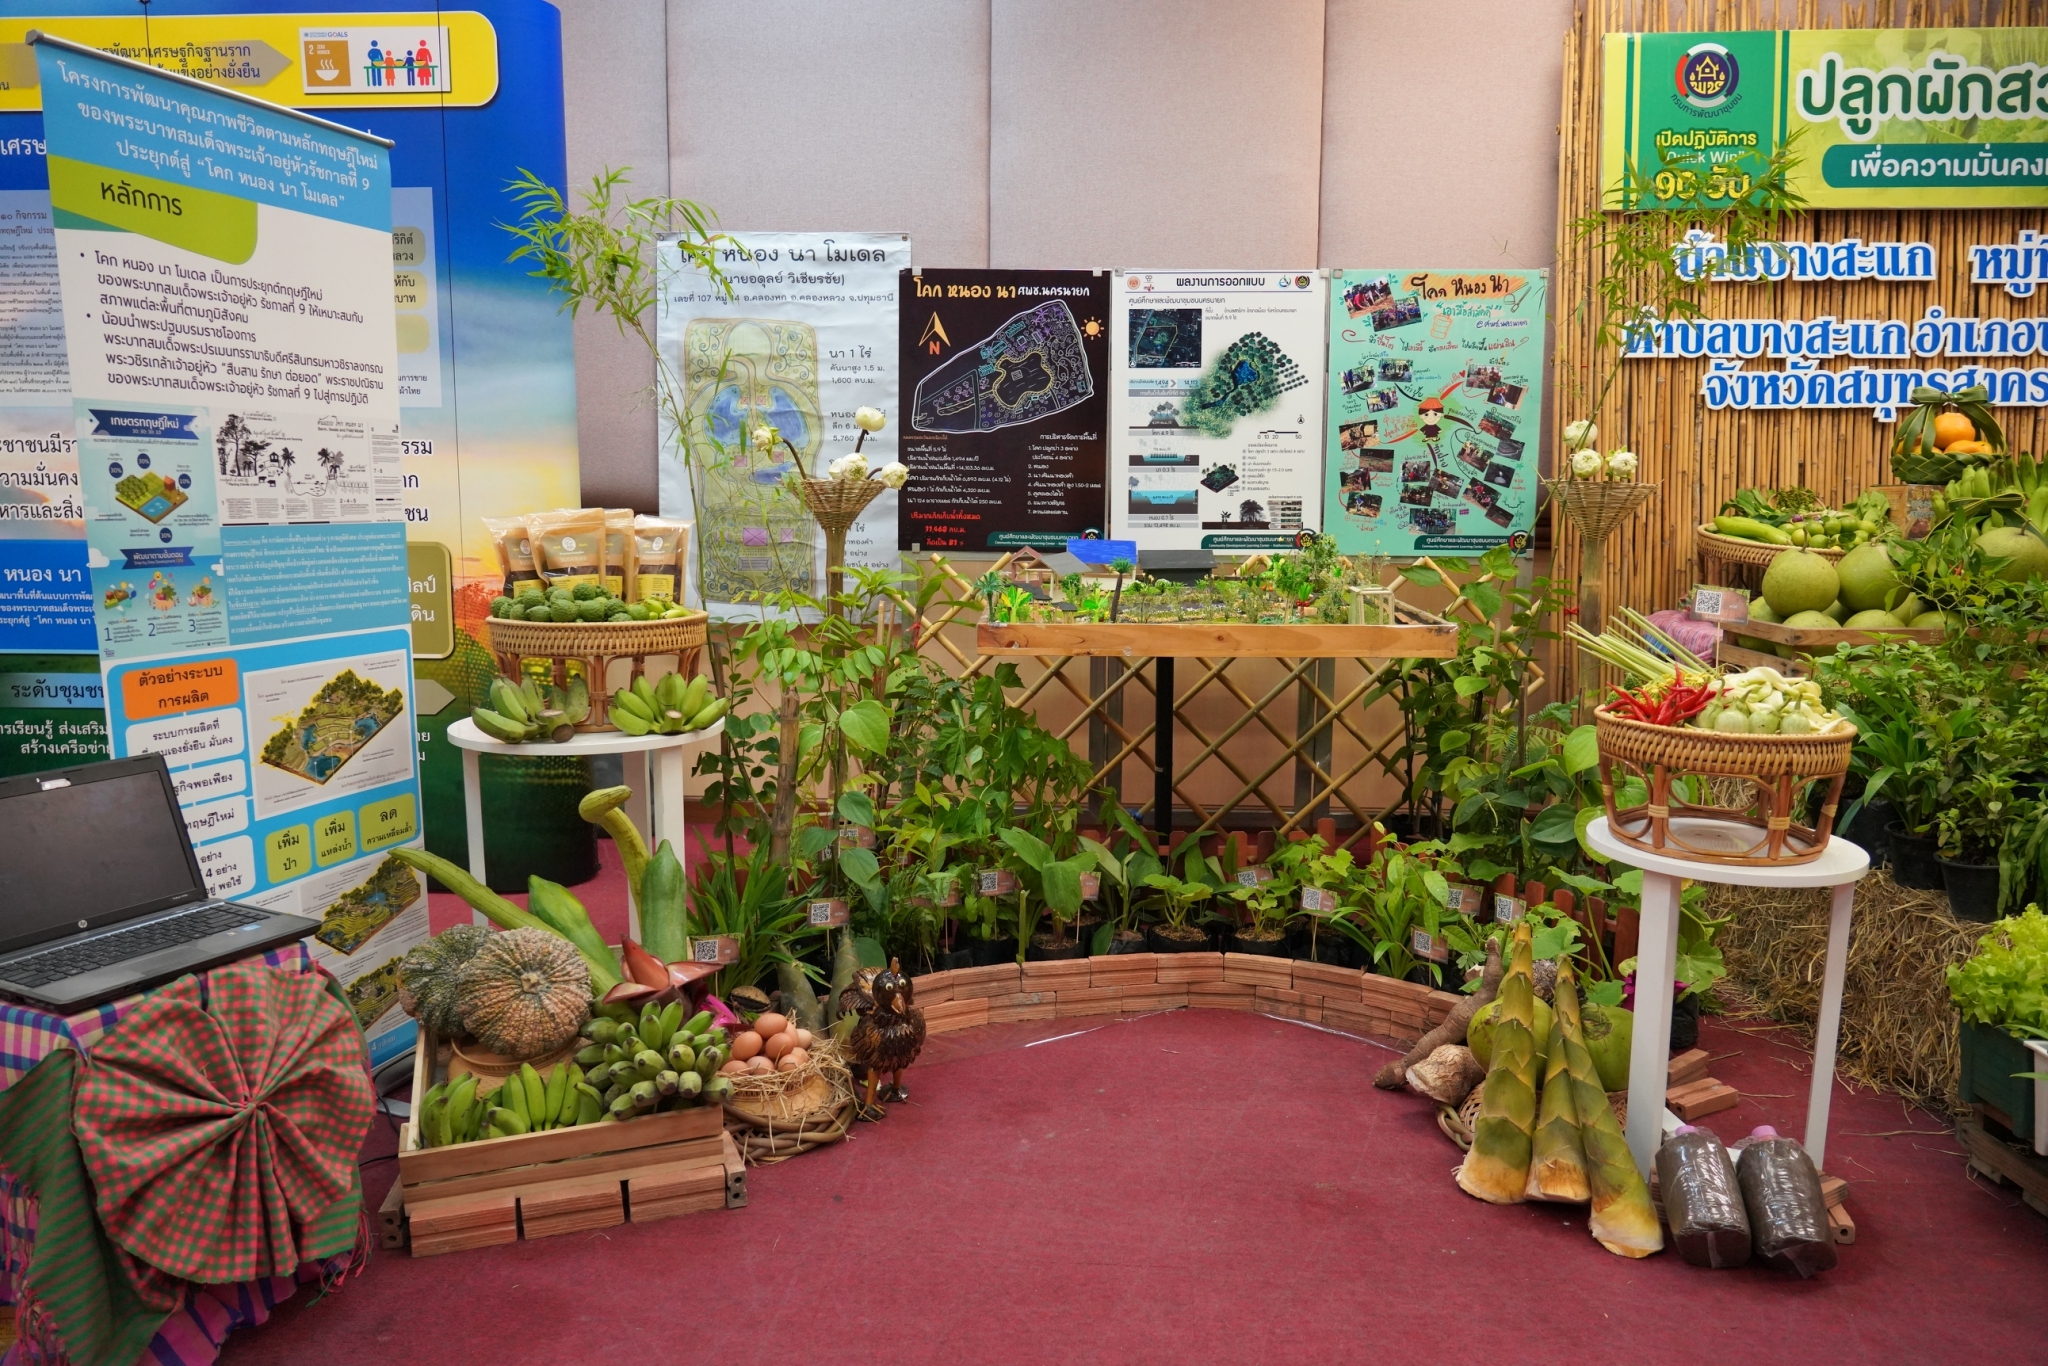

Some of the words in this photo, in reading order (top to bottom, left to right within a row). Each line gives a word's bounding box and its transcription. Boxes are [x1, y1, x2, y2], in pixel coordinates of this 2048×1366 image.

[308, 44, 315, 55] 2
[57, 60, 379, 169] โครงการพัฒนาคุณภาพชีวิตตามหลักทฤษฎีใหม่
[1670, 93, 1744, 119] กรมการพัฒนาชุมชน
[78, 101, 358, 188] ของพระบาทสมเด็จพระเจ้าอยู่หัวรัชกาลที่
[362, 178, 370, 191] 9
[1655, 129, 1758, 150] เปิดปฏิบัติการ
[116, 139, 191, 178] ประยุกต์สู่
[238, 171, 275, 193] หนอง
[279, 182, 298, 198] นา
[1850, 143, 2048, 178] เพื่อความมั่นคง
[100, 179, 183, 216] หลักการ
[15, 209, 47, 220] กิจกรรม
[722, 247, 779, 263] หนอง
[788, 247, 816, 263] นา
[824, 239, 886, 263] โมเดล
[1675, 231, 1934, 280] บ้านบางสะแก
[94, 250, 118, 267] โคก
[122, 258, 154, 273] หนอง
[158, 265, 172, 276] นา
[174, 264, 207, 281] โมเดล
[211, 269, 323, 301] เป็นการประยุกต์ทฤษฎีใหม่
[1176, 276, 1266, 288] ผลงานการออกแบบ
[913, 276, 943, 298] โคก
[947, 284, 992, 298] หนอง
[996, 285, 1016, 298] นา
[1017, 286, 1091, 297] ศพช.นครนายก
[1410, 273, 1448, 300] โคก
[1450, 277, 1487, 296] หนอง
[1489, 274, 1510, 294] นา
[97, 273, 258, 309] ของพระบาทสมเด็จพระเจ้าอยู่หัว
[260, 297, 296, 314] รัชกาลที่
[299, 303, 306, 315] 9
[308, 303, 364, 324] ให้เหมาะสมกับ
[394, 294, 416, 303] บาท
[674, 291, 695, 304] เลขที่
[697, 294, 711, 303] 107
[715, 293, 728, 306] หมู่
[849, 292, 894, 306] จ.ปทุมธานี
[99, 293, 249, 324] สภาพแต่ละพื้นที่ตามภูมิสังคม
[1624, 306, 1908, 355] ตำบลบางสะแก
[828, 349, 845, 359] นา
[849, 349, 855, 359] 1
[857, 345, 872, 359] ไร่
[929, 341, 941, 355] N
[107, 372, 265, 399] ของพระบาทสมเด็จพระเจ้าอยู่หัว
[267, 384, 301, 399] รัชกาลที่
[304, 388, 311, 400] 9
[260, 367, 282, 381] รักษา
[325, 375, 384, 390] พระราชปณิธาน
[831, 377, 852, 385] 1,600
[110, 415, 180, 431] เกษตรทฤษฎีใหม่
[832, 421, 843, 430] ลึก
[845, 422, 851, 430] 6
[832, 434, 855, 443] 5,760
[854, 521, 866, 533] ไร่
[3, 568, 53, 582] หนอง
[58, 568, 82, 582] นา
[148, 623, 157, 637] 2
[188, 619, 197, 632] 3
[104, 627, 113, 642] 1
[138, 664, 223, 687] ตัวอย่างระบบ
[158, 689, 210, 709] การผลิต
[152, 718, 221, 741] ระบบการผลิตที่
[209, 734, 234, 749] มั่นคง
[379, 807, 398, 824] ลด
[324, 820, 346, 837] เพิ่ม
[366, 822, 413, 846] ความเหลื่อมล้ำ
[277, 833, 300, 850] เพิ่ม
[321, 838, 352, 858] แหล่งน้ำ
[200, 850, 222, 865] อย่าง
[283, 856, 297, 872] ป่า
[205, 867, 213, 878] 4
[215, 862, 238, 876] อย่าง
[218, 873, 243, 891] พอใช้
[371, 1041, 378, 1052] 4
